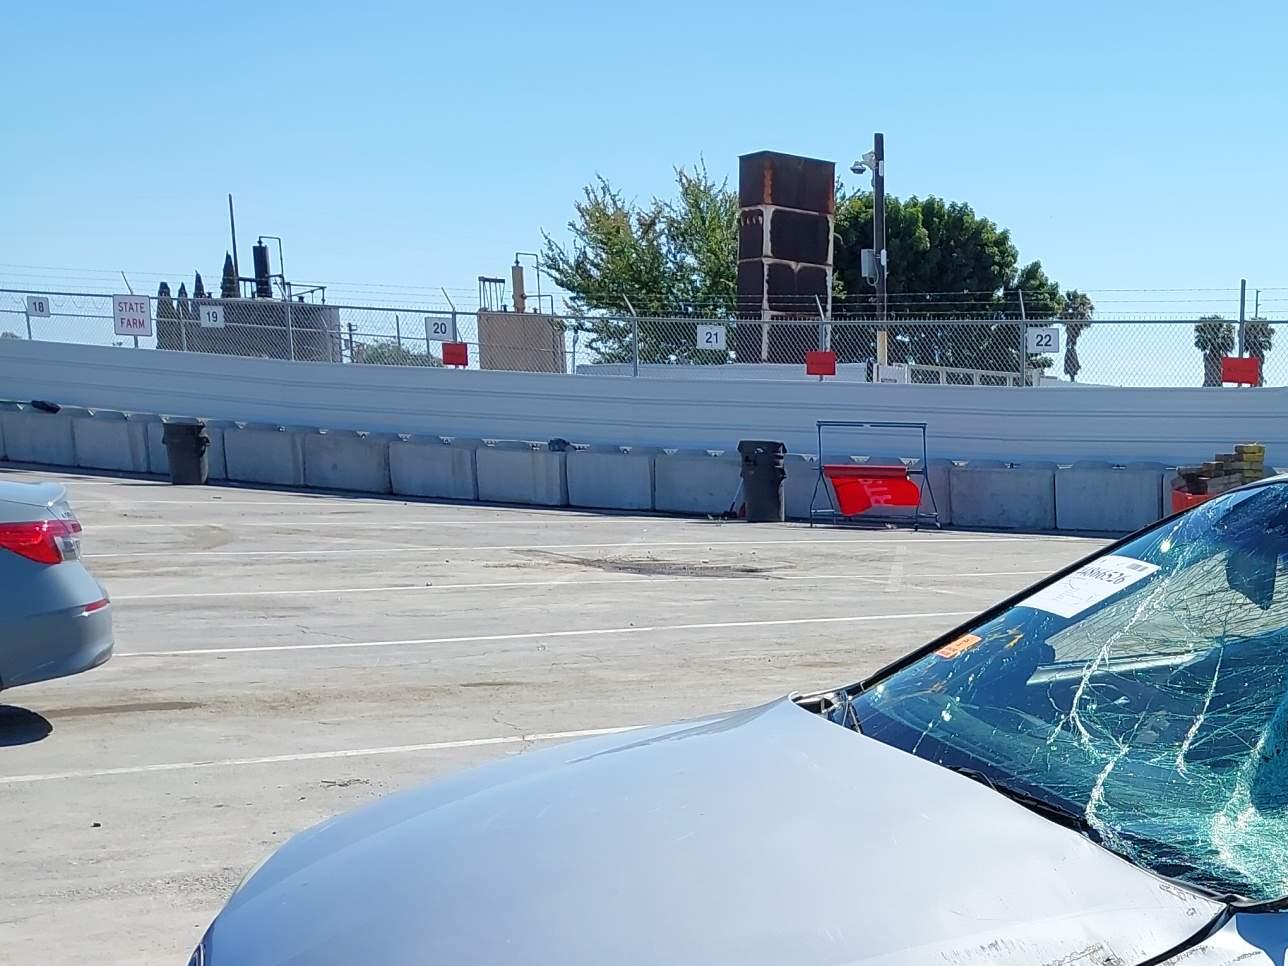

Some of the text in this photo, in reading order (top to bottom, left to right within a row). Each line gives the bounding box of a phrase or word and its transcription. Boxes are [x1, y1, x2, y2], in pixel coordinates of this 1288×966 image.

[32, 301, 44, 313] 18
[118, 301, 145, 314] STATE
[120, 317, 145, 329] FARM
[206, 311, 218, 323] 19
[433, 322, 447, 335] 20
[705, 332, 719, 344] 21
[1035, 334, 1052, 347] 22
